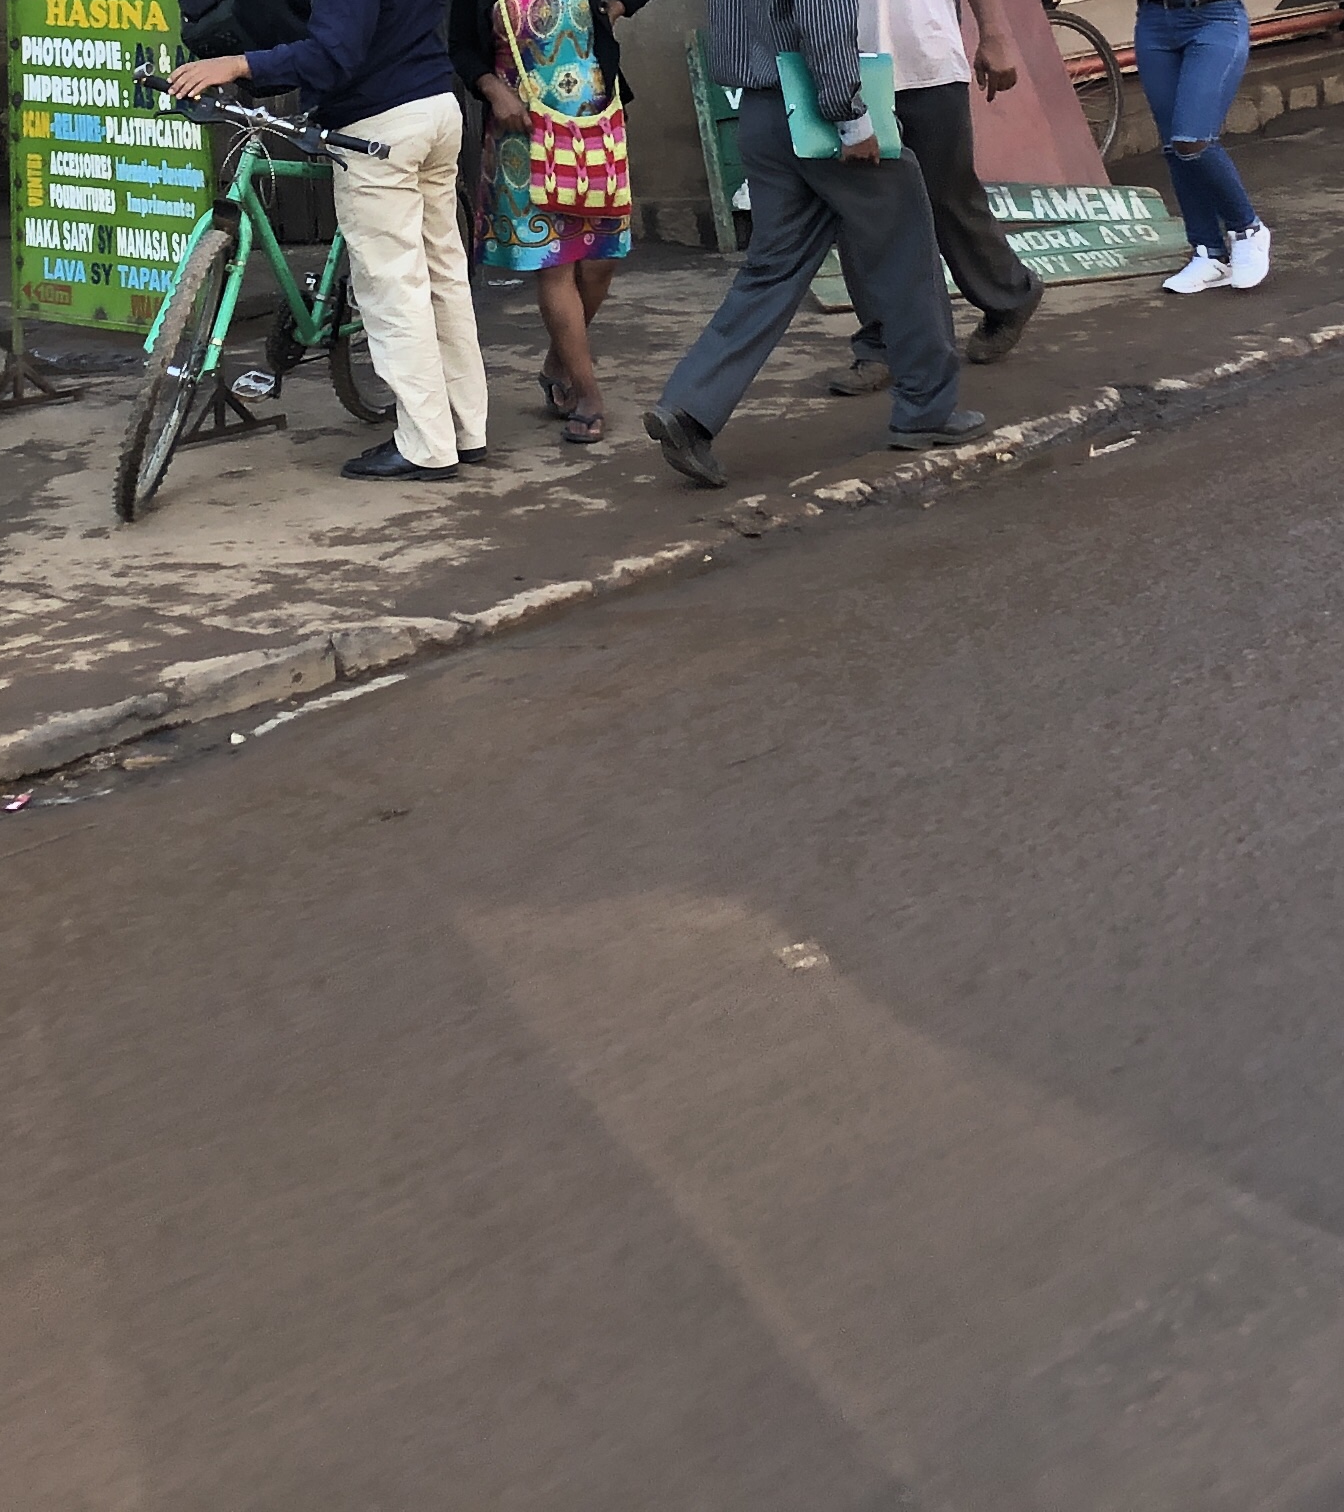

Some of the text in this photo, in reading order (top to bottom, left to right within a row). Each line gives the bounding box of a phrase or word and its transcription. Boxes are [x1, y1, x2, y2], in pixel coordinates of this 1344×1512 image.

[49, 150, 113, 181] ACCESSOIRES
[49, 183, 116, 215] FOURNITURES
[985, 185, 1152, 221] OLAMENA
[25, 217, 193, 264] MAKA SARY SY MANASA SA
[43, 256, 175, 293] LAVA SY TAPAK
